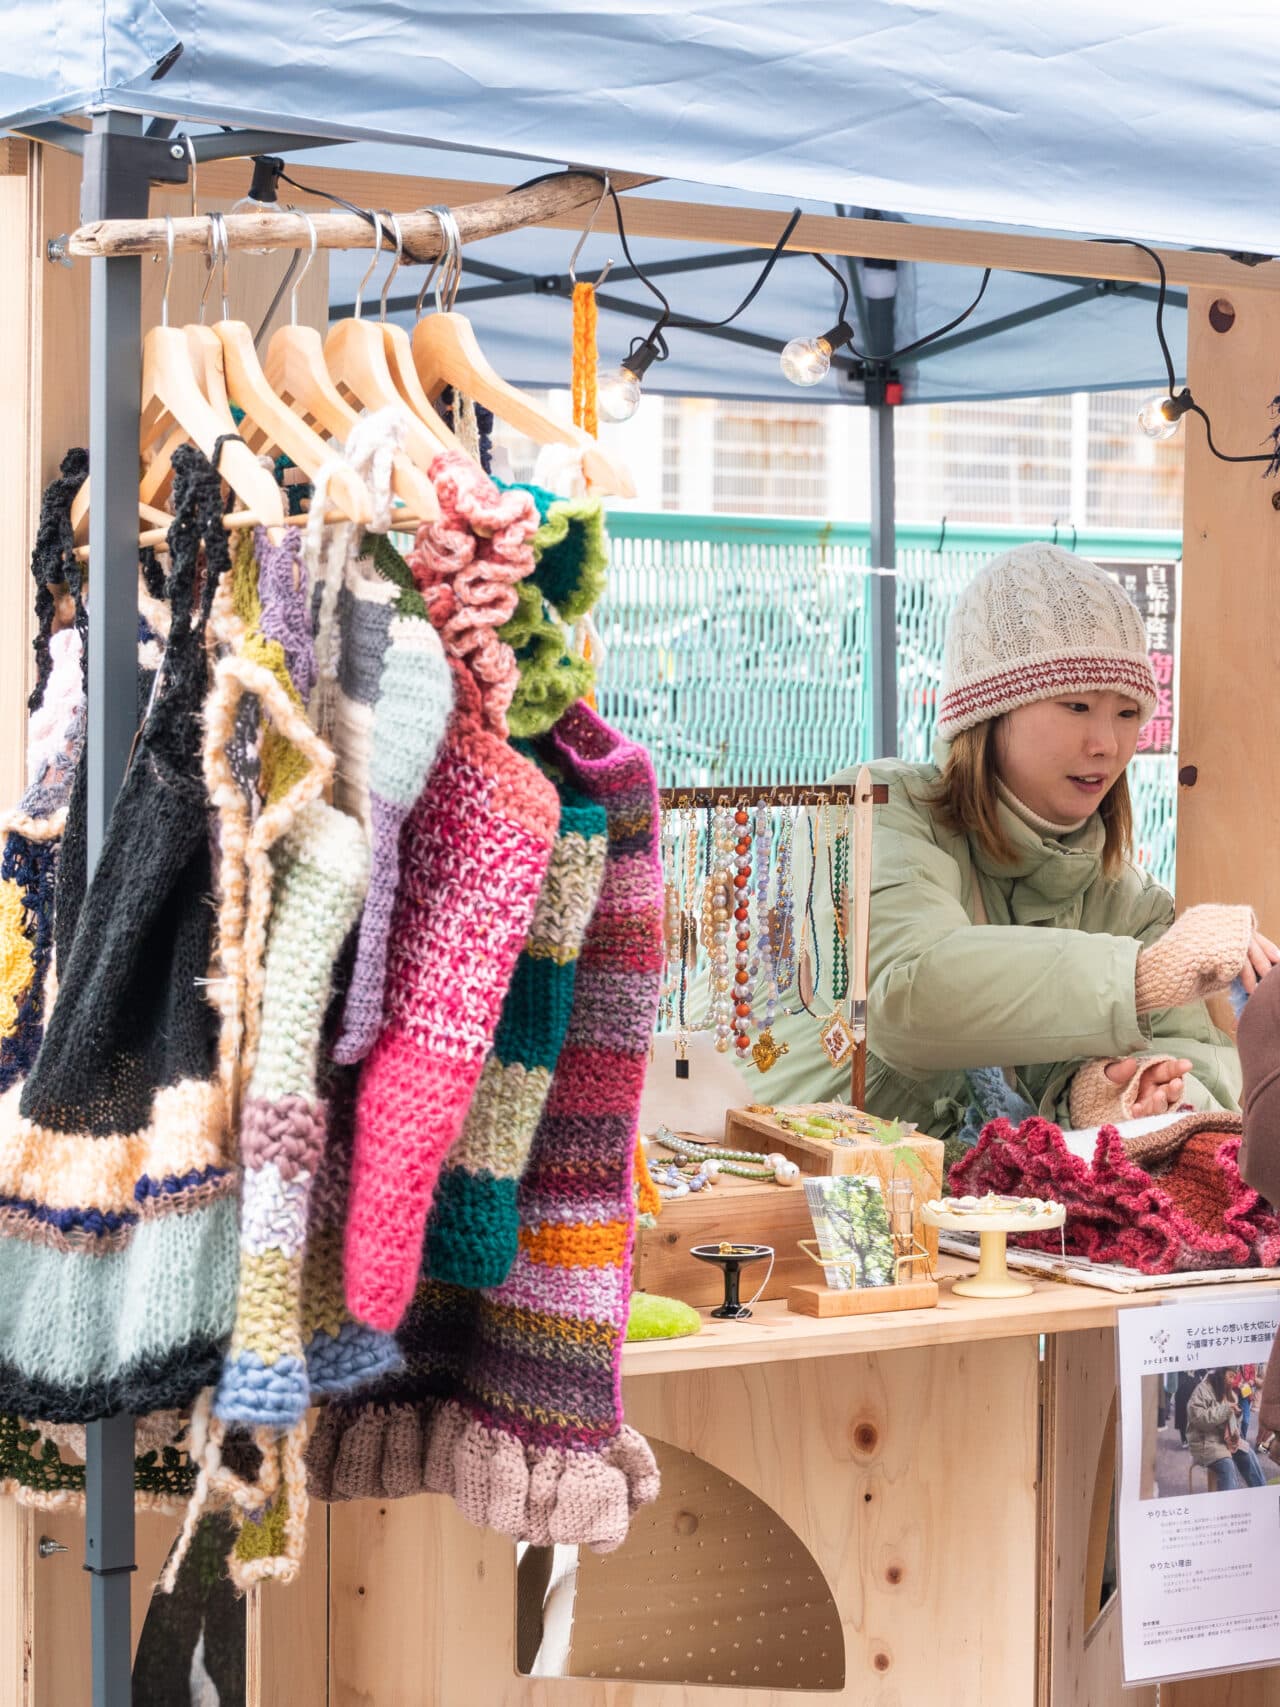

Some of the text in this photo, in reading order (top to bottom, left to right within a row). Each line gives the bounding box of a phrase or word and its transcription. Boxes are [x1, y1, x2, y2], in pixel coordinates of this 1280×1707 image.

[1146, 1507, 1190, 1519] やりたいこと
[1150, 1559, 1192, 1571] やりたい理由
